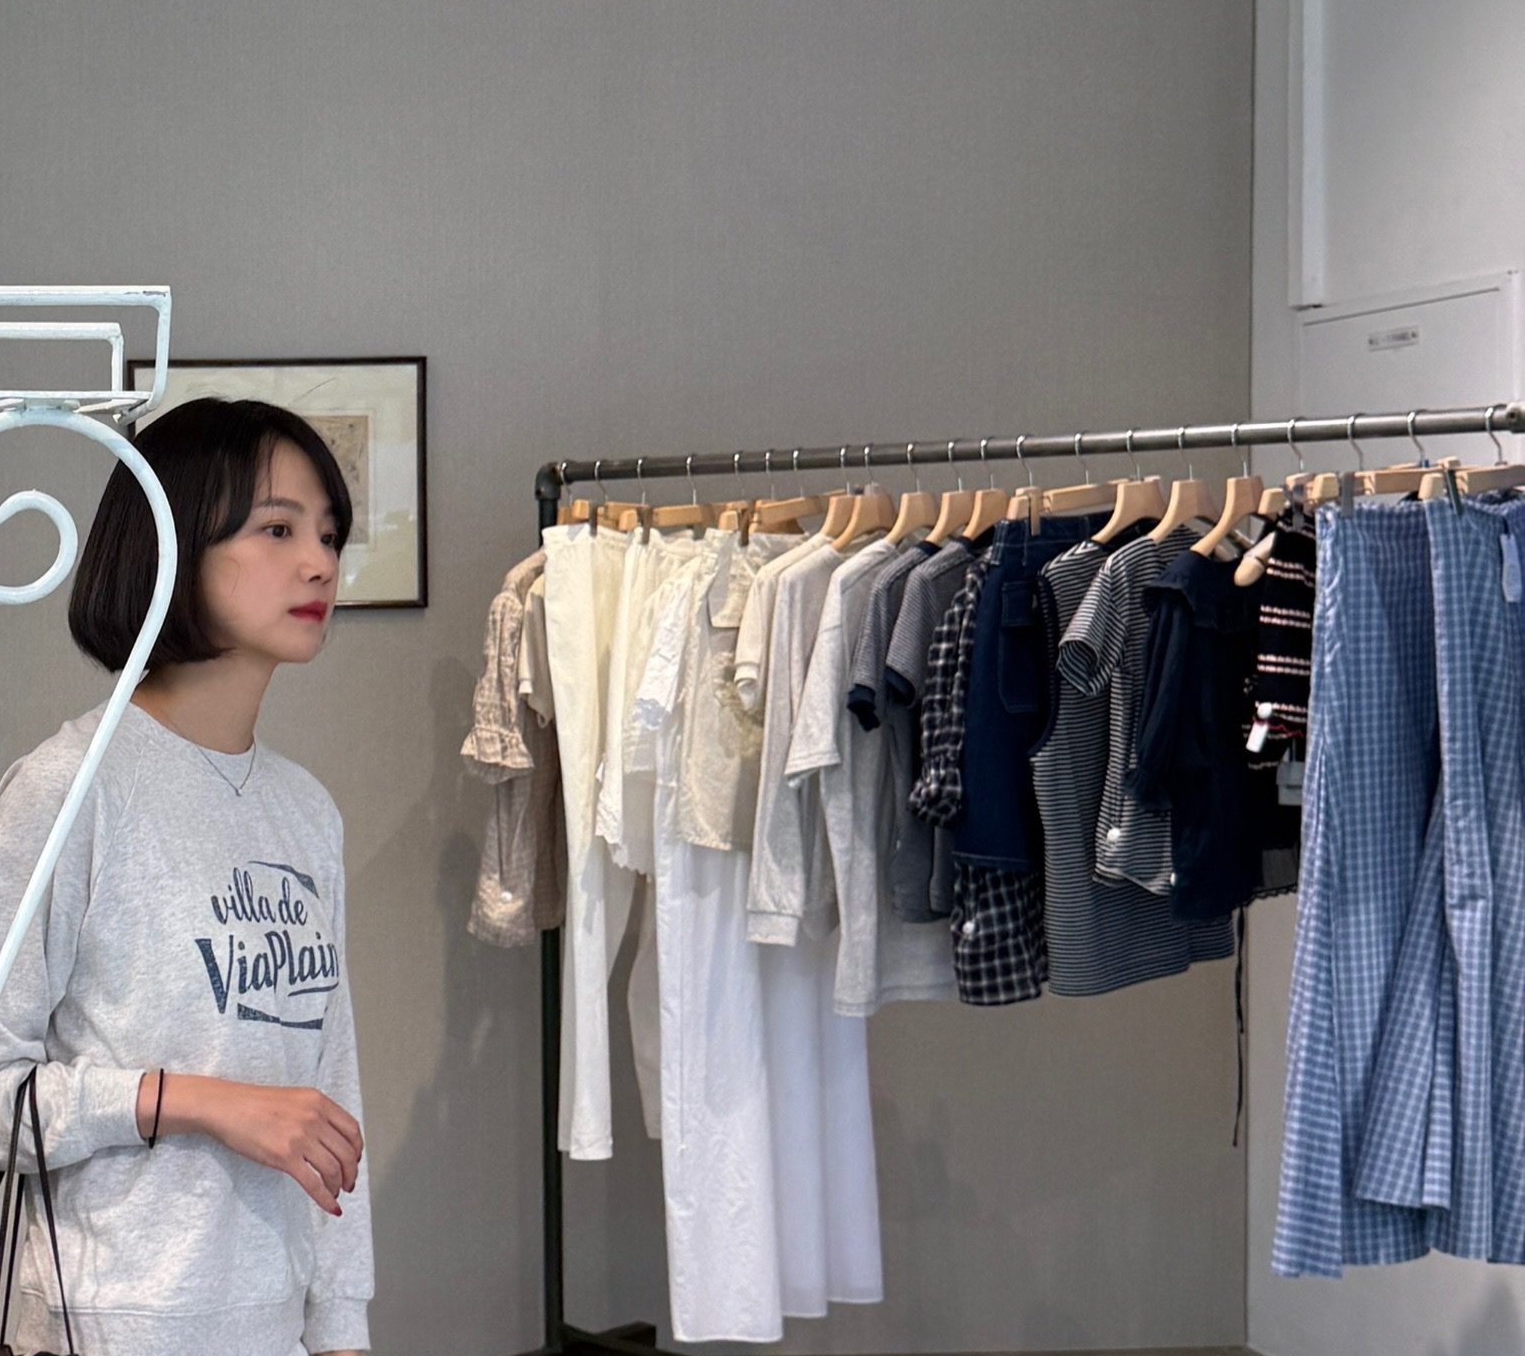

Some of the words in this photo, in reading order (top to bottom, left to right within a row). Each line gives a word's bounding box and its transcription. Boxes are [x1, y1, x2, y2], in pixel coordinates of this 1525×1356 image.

[210, 867, 276, 925] villa
[278, 876, 308, 926] de
[194, 930, 339, 1014] ViaPlain
